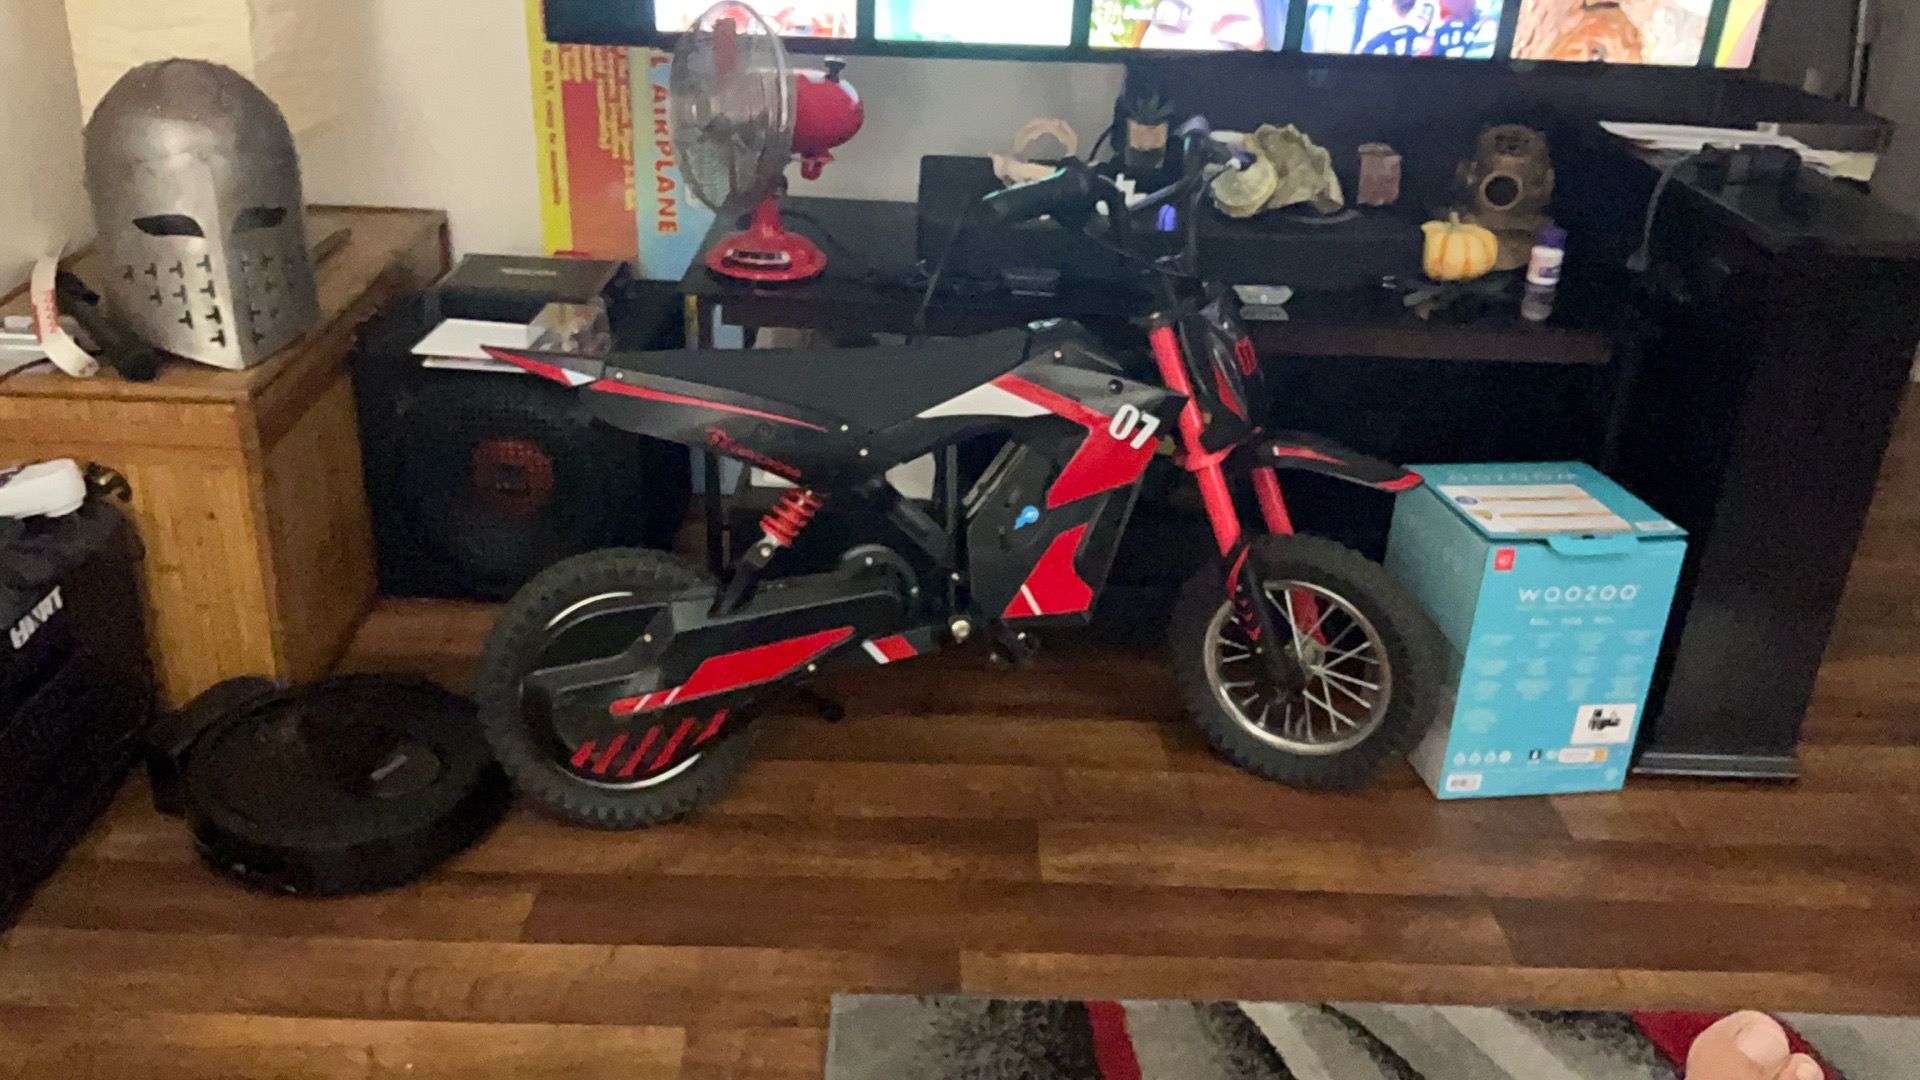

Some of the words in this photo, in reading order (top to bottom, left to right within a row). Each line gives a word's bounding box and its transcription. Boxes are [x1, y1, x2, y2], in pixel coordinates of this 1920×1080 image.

[653, 84, 678, 233] AIRPLANE
[1108, 403, 1160, 450] 07
[1518, 585, 1638, 603] WOOZOO
